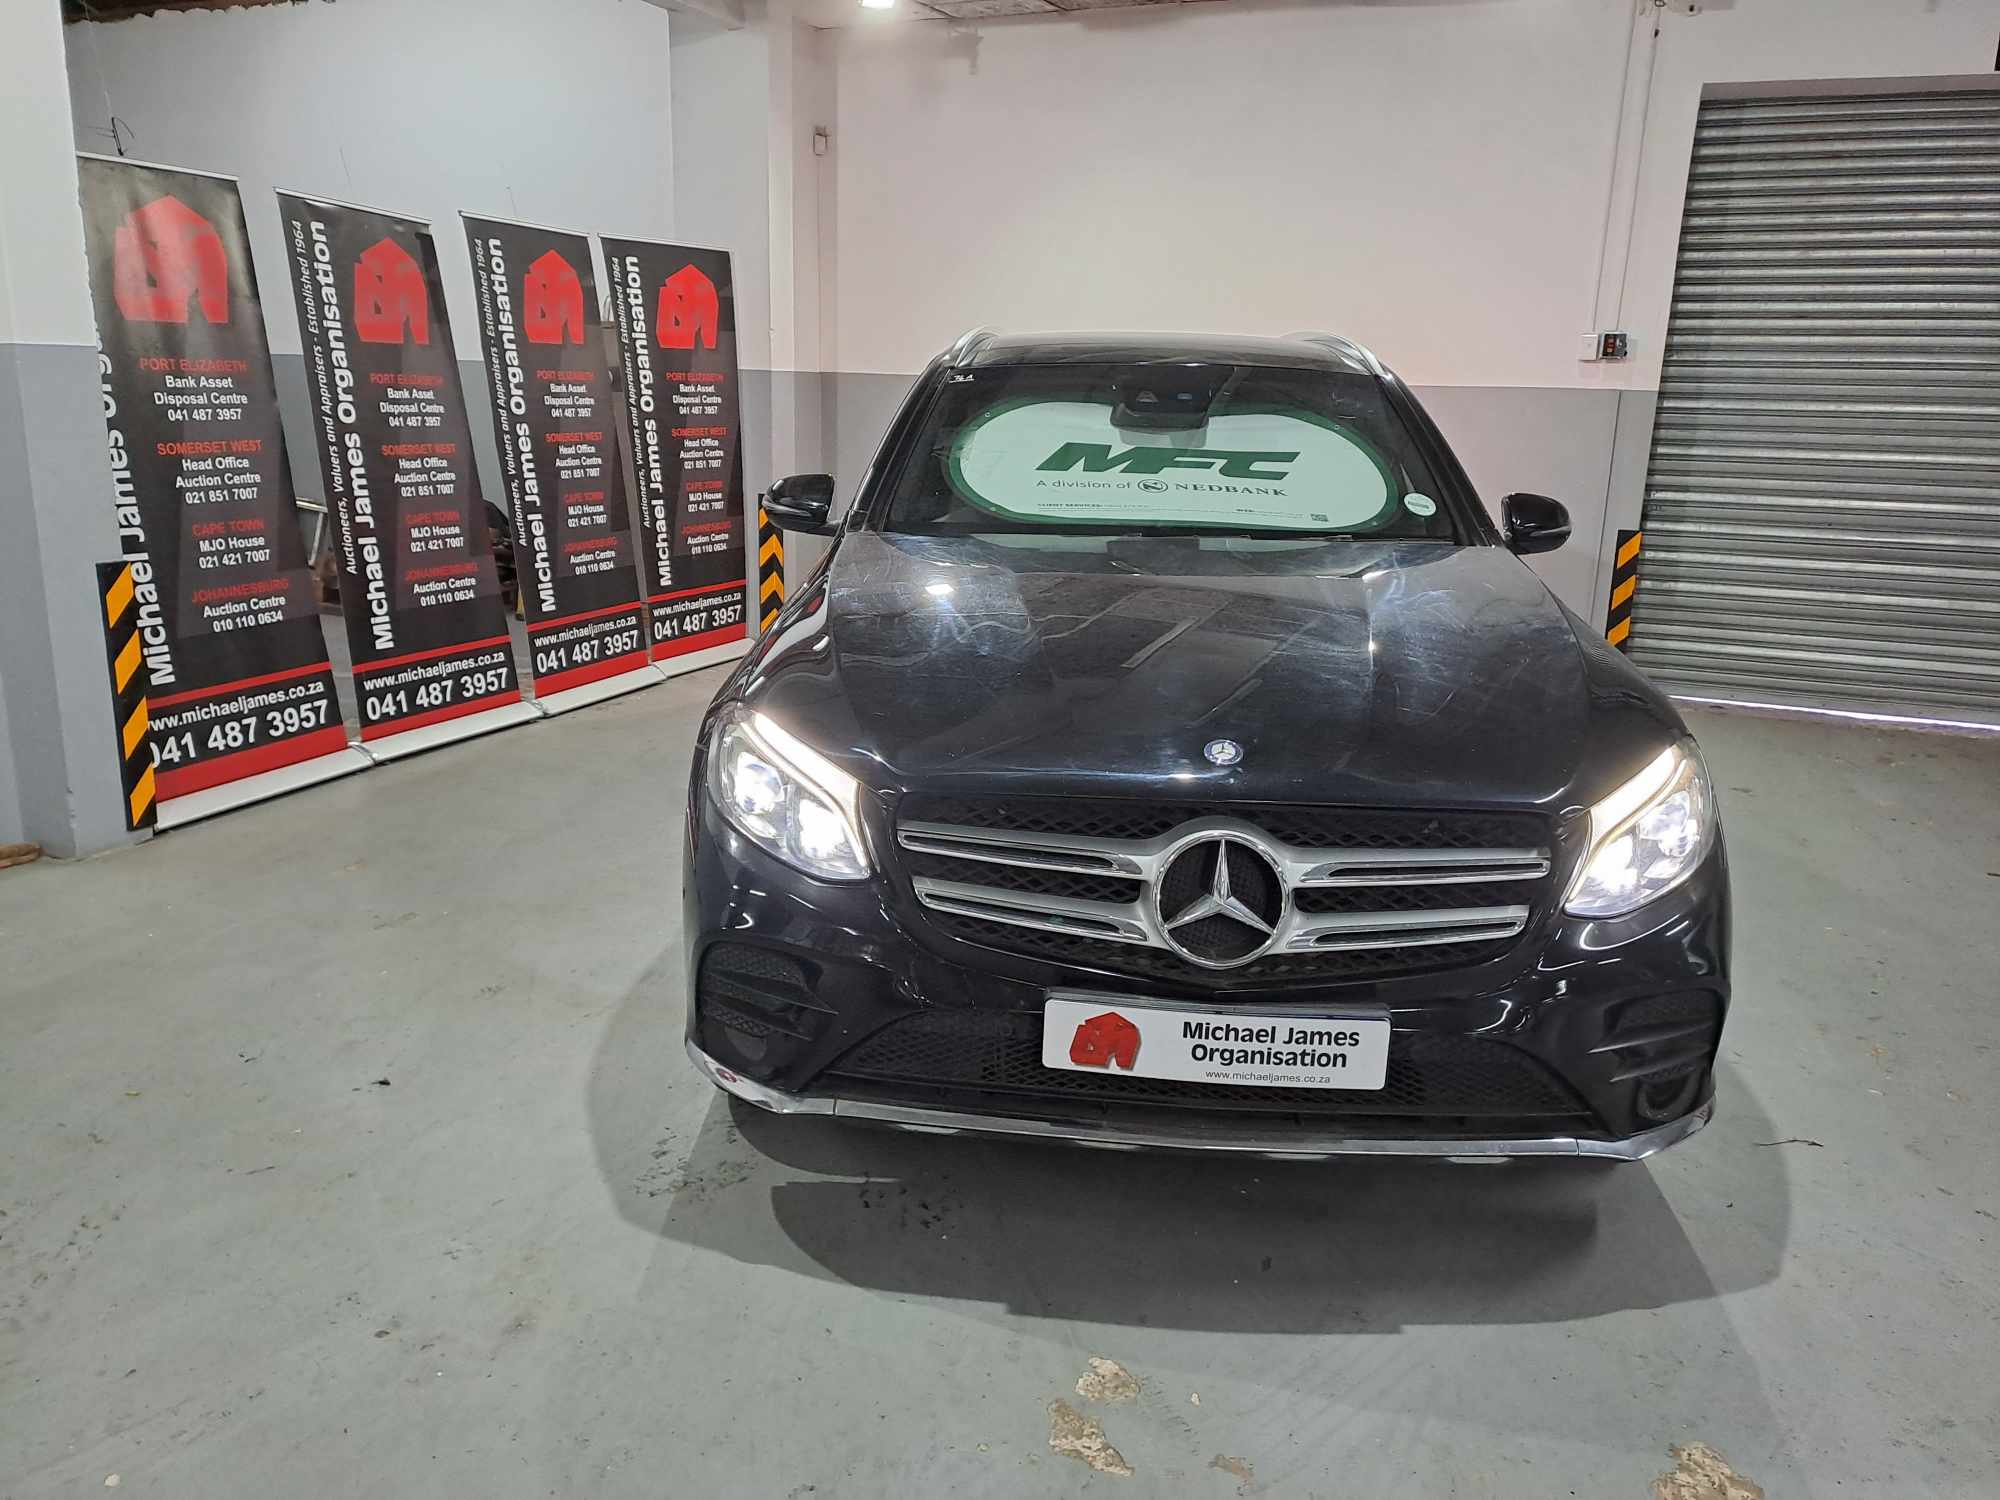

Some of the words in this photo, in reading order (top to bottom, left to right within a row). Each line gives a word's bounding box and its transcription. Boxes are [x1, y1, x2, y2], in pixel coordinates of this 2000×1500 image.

[291, 219, 306, 255] 1964
[474, 238, 486, 269] 1964
[297, 257, 319, 334] Established
[476, 270, 496, 337] Established
[311, 221, 357, 424] Organisation
[614, 284, 630, 343] Established
[488, 238, 526, 415] Organisation
[626, 256, 654, 412] Organisation
[140, 357, 176, 371] PORT
[165, 375, 197, 388] Bank
[200, 375, 233, 388] Asset
[313, 345, 332, 415] Appraisers
[491, 347, 507, 407] Appraisers
[624, 352, 638, 405] Appraisers
[679, 384, 695, 392] Bank
[697, 384, 715, 393] Asset
[153, 392, 208, 407] Disposal
[210, 392, 248, 405] Centre
[387, 388, 409, 399] Bank
[412, 388, 433, 400] Asset
[168, 408, 189, 421] 041
[192, 408, 212, 421] 487
[216, 408, 242, 420] 3957
[379, 402, 418, 415] Disposal
[420, 403, 445, 414] Centre
[498, 408, 510, 431] and
[630, 406, 639, 426] and
[321, 417, 337, 443] and
[389, 416, 403, 427] 041
[406, 416, 421, 426] 487
[157, 441, 227, 455] SOMERSET
[231, 440, 262, 452] WEST
[502, 433, 516, 475] Valuers
[633, 428, 644, 465] Valuers
[645, 419, 663, 493] James
[679, 450, 703, 459] Auction
[182, 458, 212, 471] Head
[215, 456, 249, 469] Office
[328, 446, 345, 493] Valuers
[399, 459, 421, 470] Head
[424, 457, 448, 468] Office
[516, 422, 541, 507] James
[555, 457, 580, 467] Auction
[1035, 442, 1300, 480] MFC
[109, 430, 145, 543] James
[175, 473, 222, 489] Auction
[224, 472, 262, 485] Centre
[344, 433, 375, 529] James
[394, 472, 428, 484] Auction
[430, 471, 456, 482] Centre
[1036, 480, 1047, 488] A
[1052, 480, 1111, 489] division
[1116, 481, 1131, 489] of
[1175, 483, 1288, 497] NEDBANK
[185, 491, 206, 504] 021
[209, 490, 229, 502] 851
[231, 487, 258, 500] 7007
[401, 486, 415, 497] 021
[192, 522, 226, 537] CAPE
[337, 497, 358, 574] Auctioneers,
[411, 527, 431, 538] MJO
[433, 526, 460, 536] House
[687, 535, 710, 544] Auction
[199, 538, 226, 552] MJO
[229, 536, 265, 549] House
[411, 541, 425, 552] 021
[428, 539, 443, 550] 421
[651, 499, 672, 587] Michael
[199, 555, 219, 569] 021
[222, 553, 242, 567] 421
[246, 550, 271, 564] 7007
[527, 513, 557, 613] Michael
[569, 553, 594, 564] Auction
[357, 537, 395, 650] Michael
[413, 579, 447, 594] Auction
[449, 576, 477, 589] Centre
[203, 599, 248, 618] Auction
[251, 595, 286, 611] Centre
[438, 592, 452, 604] 110
[653, 592, 741, 617] www.michaeljames.co.za
[123, 552, 176, 686] Michael
[213, 617, 233, 632] 010
[236, 614, 255, 629] 110
[258, 610, 283, 627] 0634
[534, 615, 637, 647] www.michaeljames.co.za
[654, 618, 679, 640] 041
[683, 612, 708, 633] 487
[712, 605, 741, 627] 3957
[536, 649, 567, 673] 041
[572, 639, 600, 662] 487
[604, 630, 639, 655] 3957
[363, 650, 505, 691] www.michaeljames.co.za
[148, 680, 324, 732] ww.michaeljames.co.za
[366, 690, 408, 721] 041
[415, 680, 454, 708] 487
[460, 668, 508, 698] 3957
[207, 716, 257, 752] 487
[266, 699, 329, 738] 3957
[1183, 1021, 1276, 1044] Michael
[1283, 1027, 1360, 1047] James
[1191, 1044, 1347, 1068] Organisation
[1205, 1070, 1331, 1084] www.michaeljames.co.za
